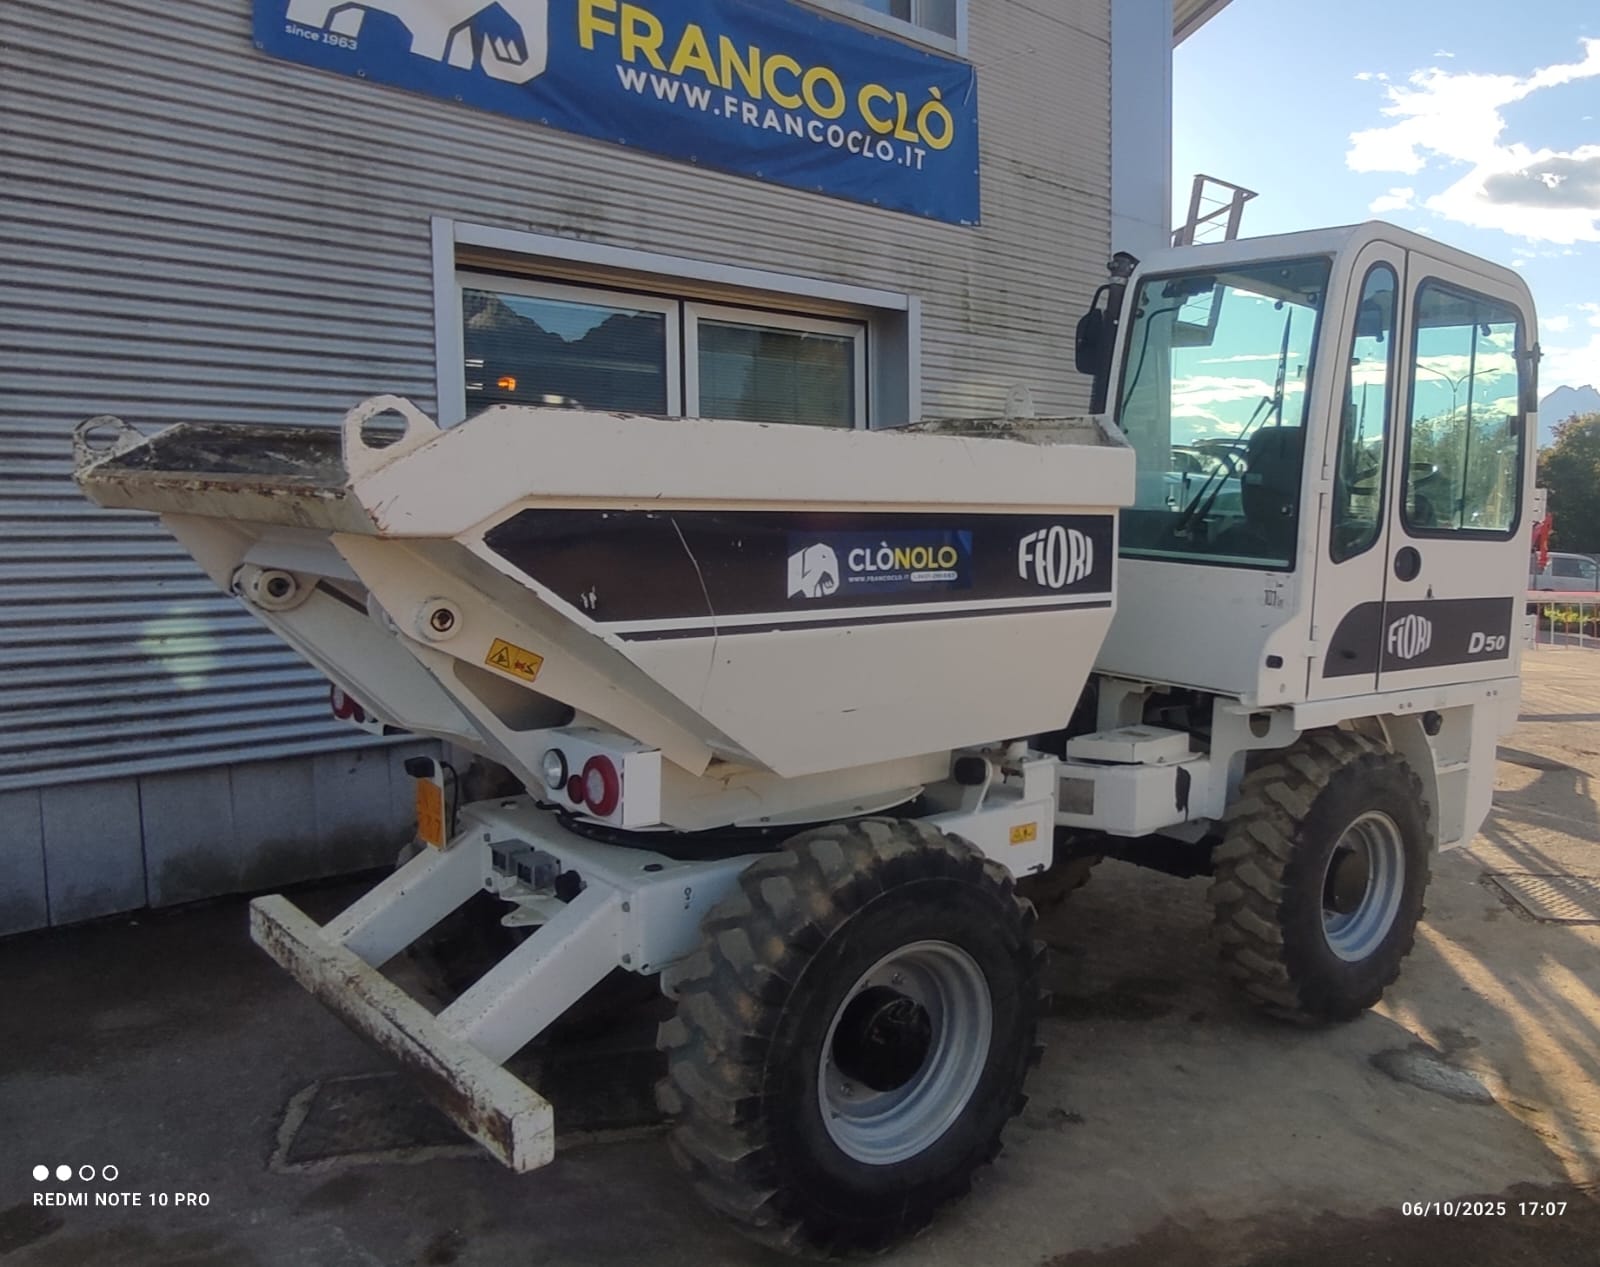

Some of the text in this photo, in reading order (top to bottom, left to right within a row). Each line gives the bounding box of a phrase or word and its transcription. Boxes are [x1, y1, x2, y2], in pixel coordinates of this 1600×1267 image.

[285, 24, 358, 50] since 1963
[577, 0, 954, 150] FRANCO CLÒ
[615, 64, 926, 170] WWW.FRANCOCLO.IT
[848, 541, 958, 571] CLÒNOLO
[1467, 632, 1506, 654] D50
